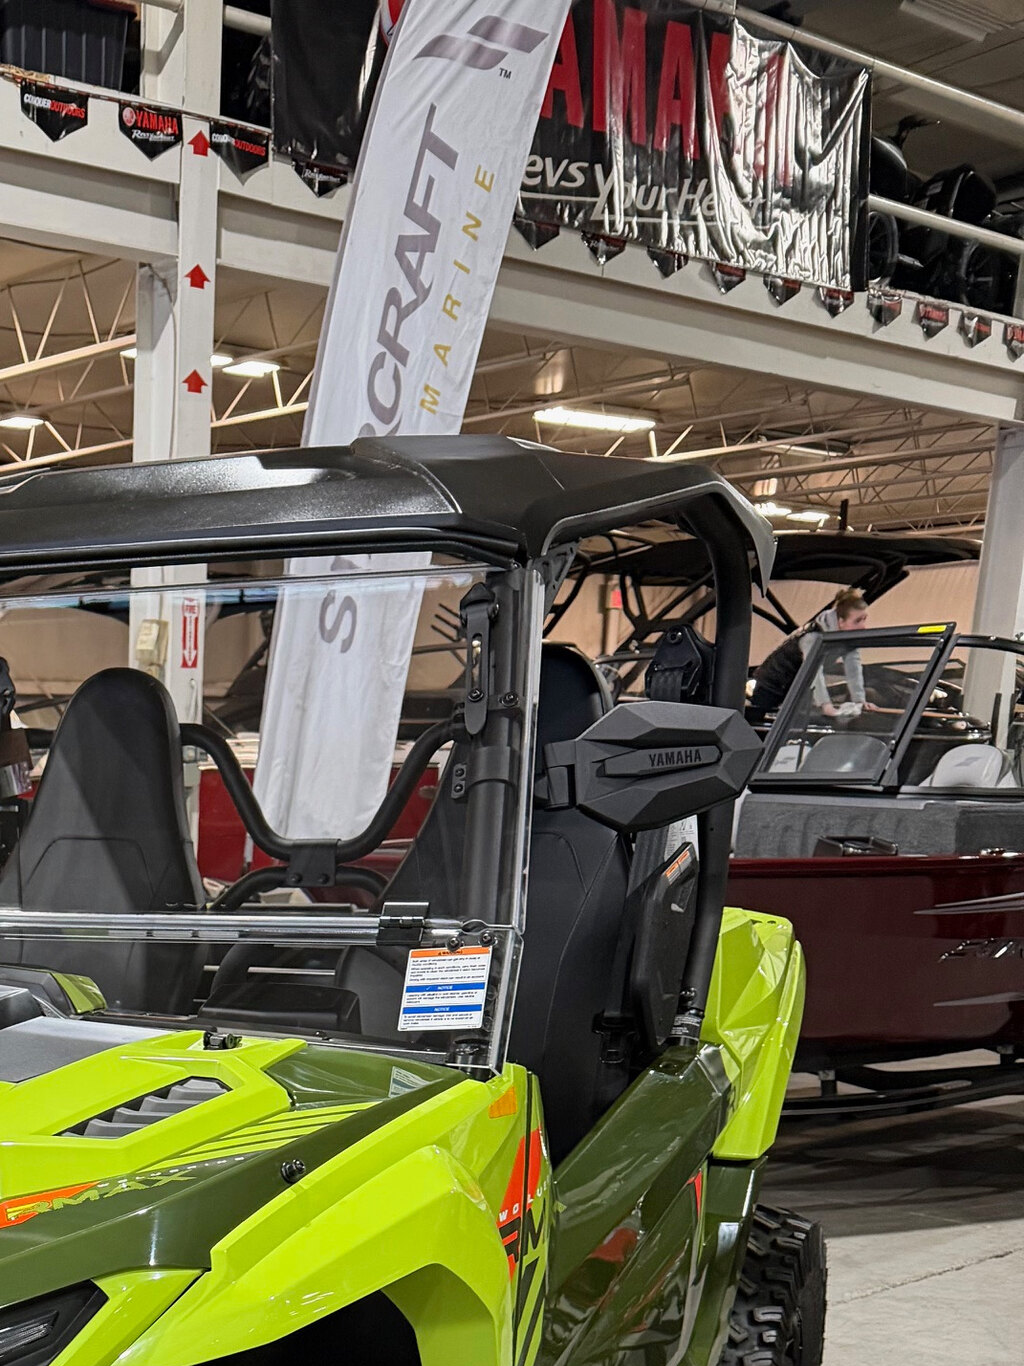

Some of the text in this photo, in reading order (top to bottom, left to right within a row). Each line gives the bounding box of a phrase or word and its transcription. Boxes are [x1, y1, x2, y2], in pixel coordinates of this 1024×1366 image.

[499, 67, 511, 79] TM
[136, 109, 178, 135] YAMAHA
[523, 154, 589, 189] evs
[420, 164, 495, 415] MARINE
[649, 749, 702, 768] YAMAHA
